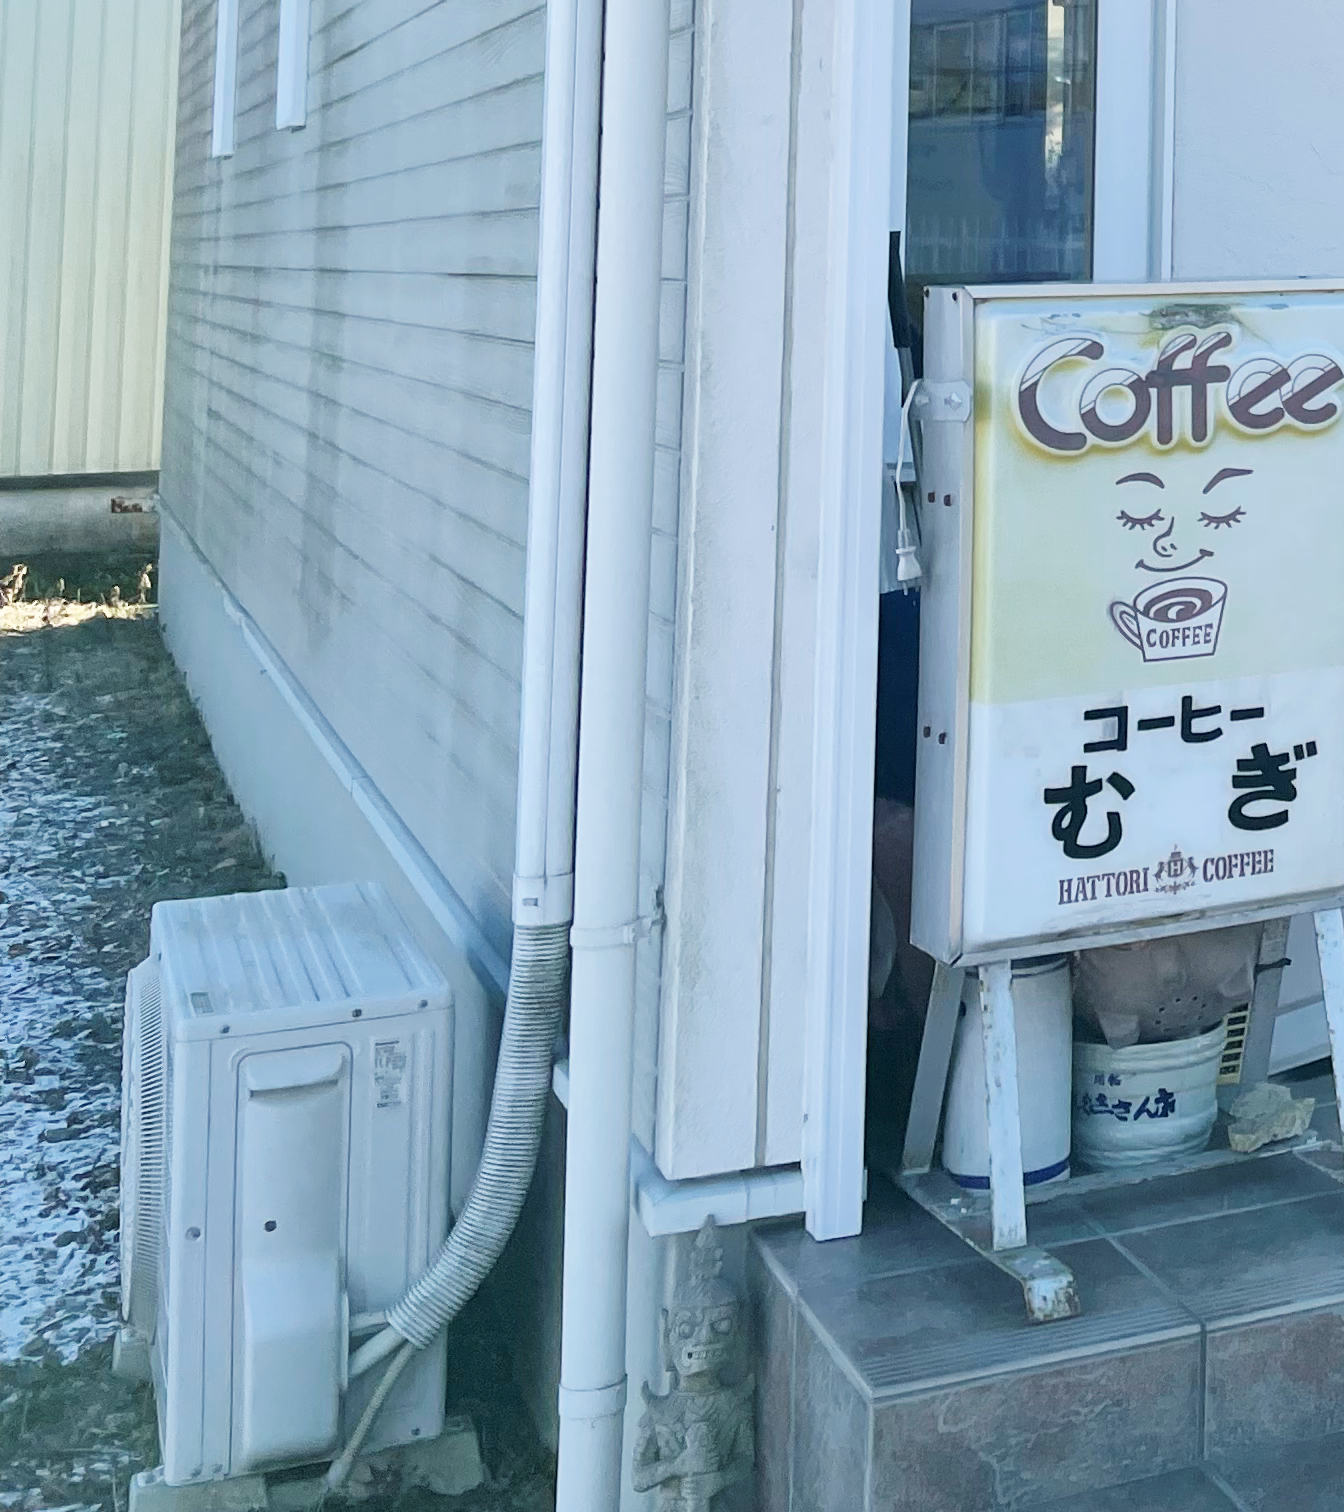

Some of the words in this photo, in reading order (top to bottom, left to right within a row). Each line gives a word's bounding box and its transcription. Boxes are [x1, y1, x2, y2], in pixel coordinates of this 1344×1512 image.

[1145, 623, 1214, 649] COFFEE
[1083, 695, 1265, 753] コーヒー
[1043, 741, 1318, 860] むぎ
[1058, 867, 1150, 905] HATTORI
[1202, 849, 1275, 883] COFFEE
